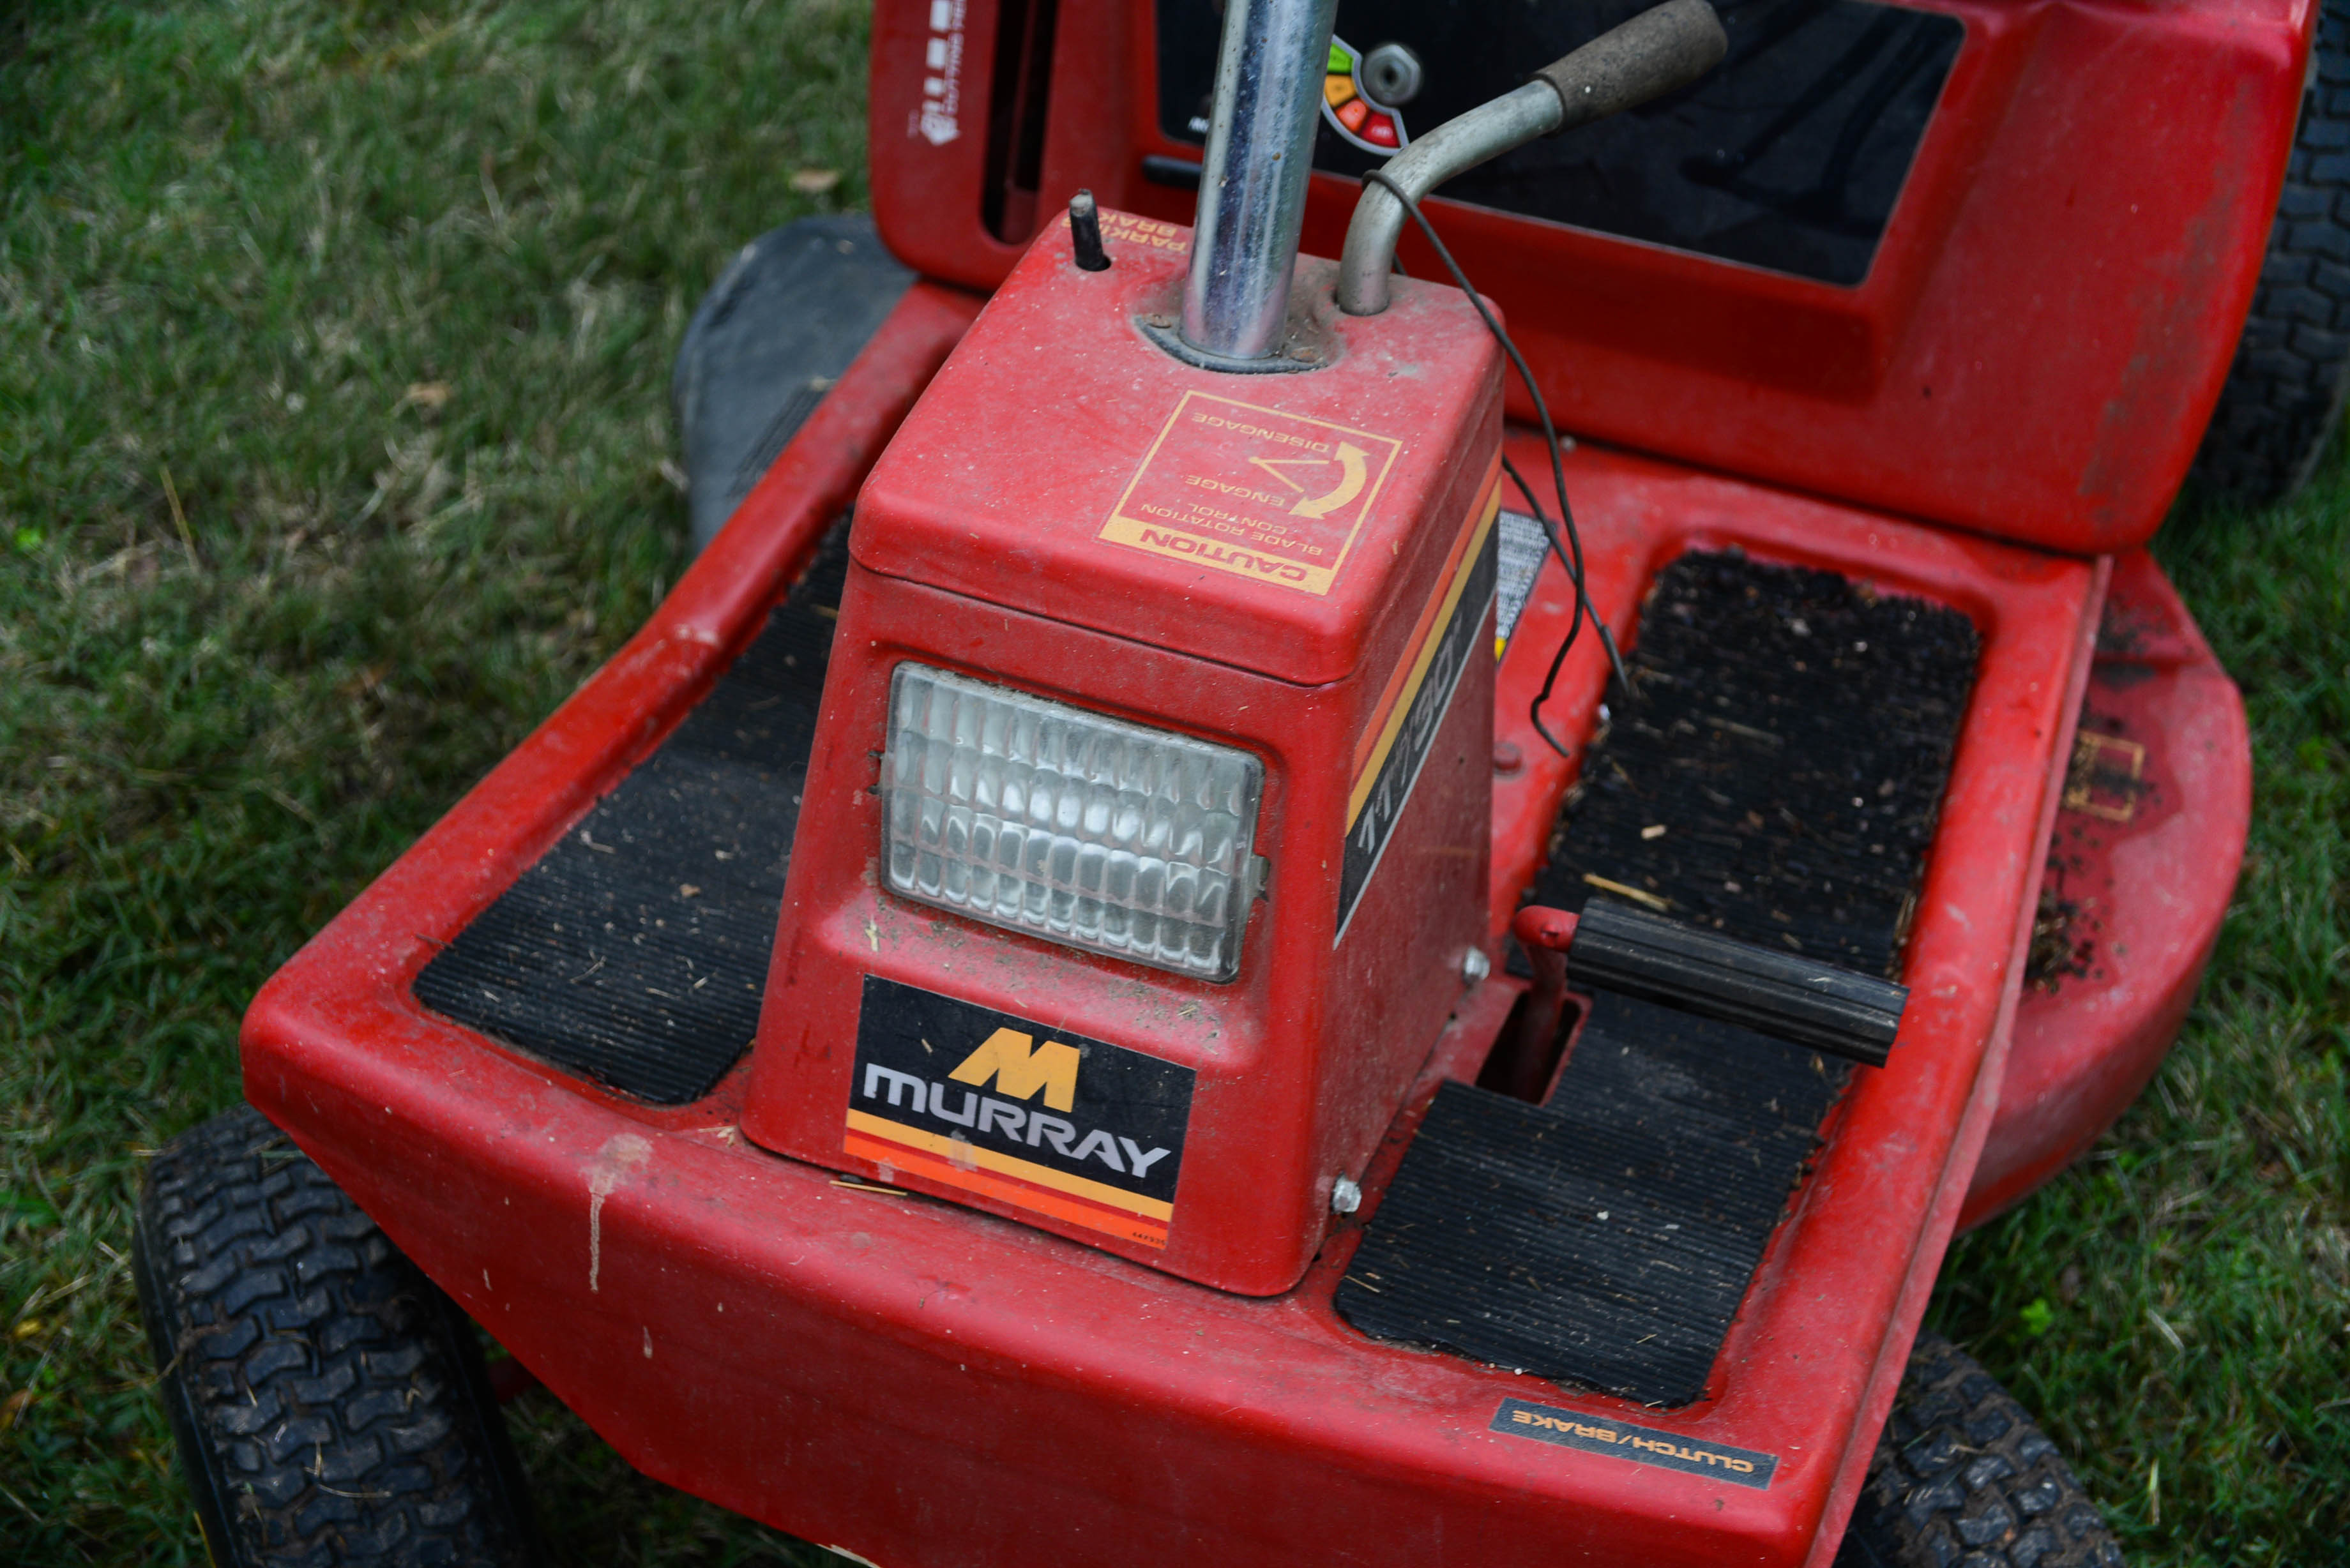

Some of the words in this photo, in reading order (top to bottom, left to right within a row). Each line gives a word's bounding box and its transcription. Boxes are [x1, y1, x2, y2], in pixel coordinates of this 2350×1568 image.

[1098, 212, 1178, 237] BRAK
[1192, 412, 1331, 453] DISENGAGE
[1185, 474, 1285, 507] ENGAGE
[1141, 503, 1245, 536] ROTATION
[1187, 502, 1288, 535] CONTROL
[1139, 529, 1308, 582] CAUTION
[1250, 531, 1324, 556] BLADE
[863, 1063, 1171, 1178] MURRAY
[1512, 1410, 1754, 1473] CLUTCH/BRAKE
